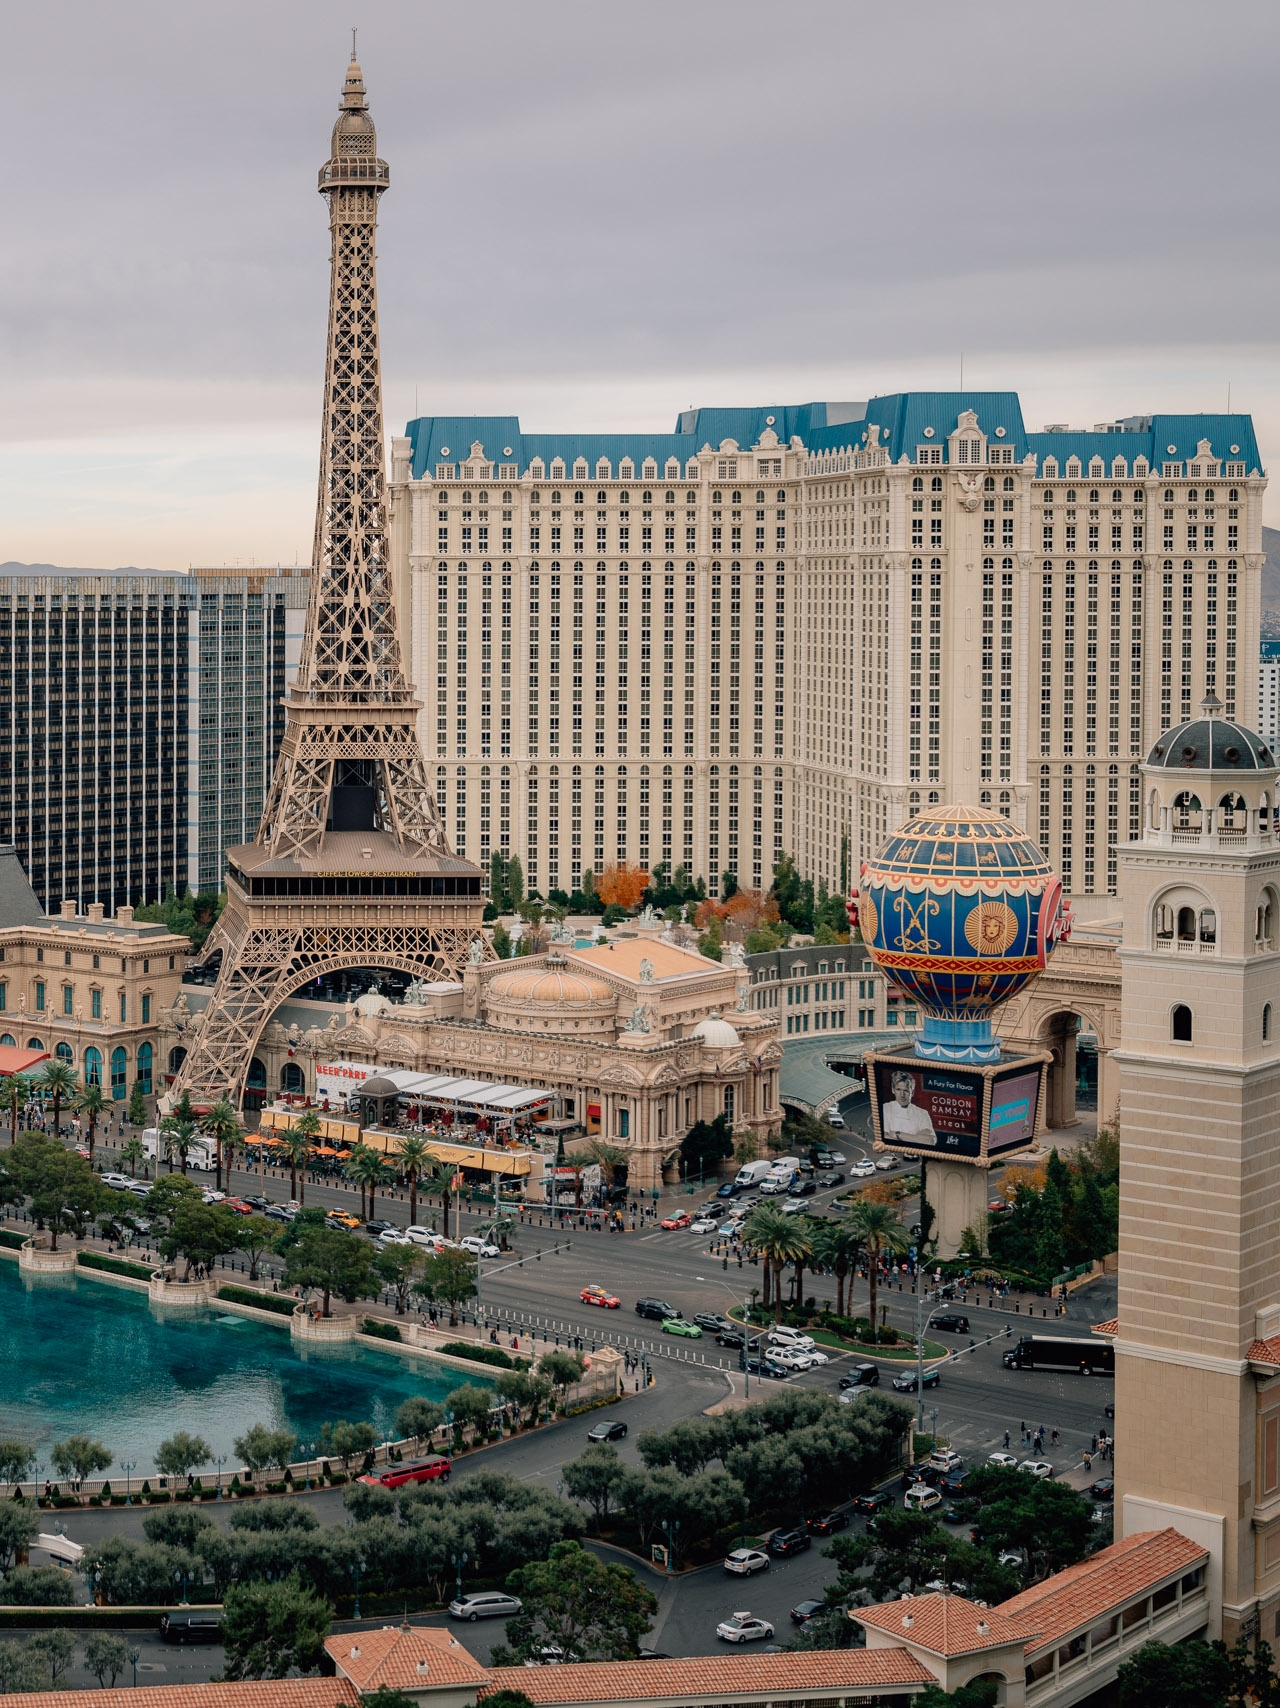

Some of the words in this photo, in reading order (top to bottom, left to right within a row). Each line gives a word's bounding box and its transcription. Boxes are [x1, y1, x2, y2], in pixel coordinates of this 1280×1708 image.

[316, 1064, 340, 1077] BEER
[342, 1068, 367, 1080] PARK
[933, 1080, 945, 1088] Fury
[946, 1081, 955, 1089] For
[956, 1083, 974, 1091] Flavor
[932, 1096, 971, 1108] GORDON
[932, 1105, 971, 1117] RAMSAY
[938, 1120, 966, 1129] steak
